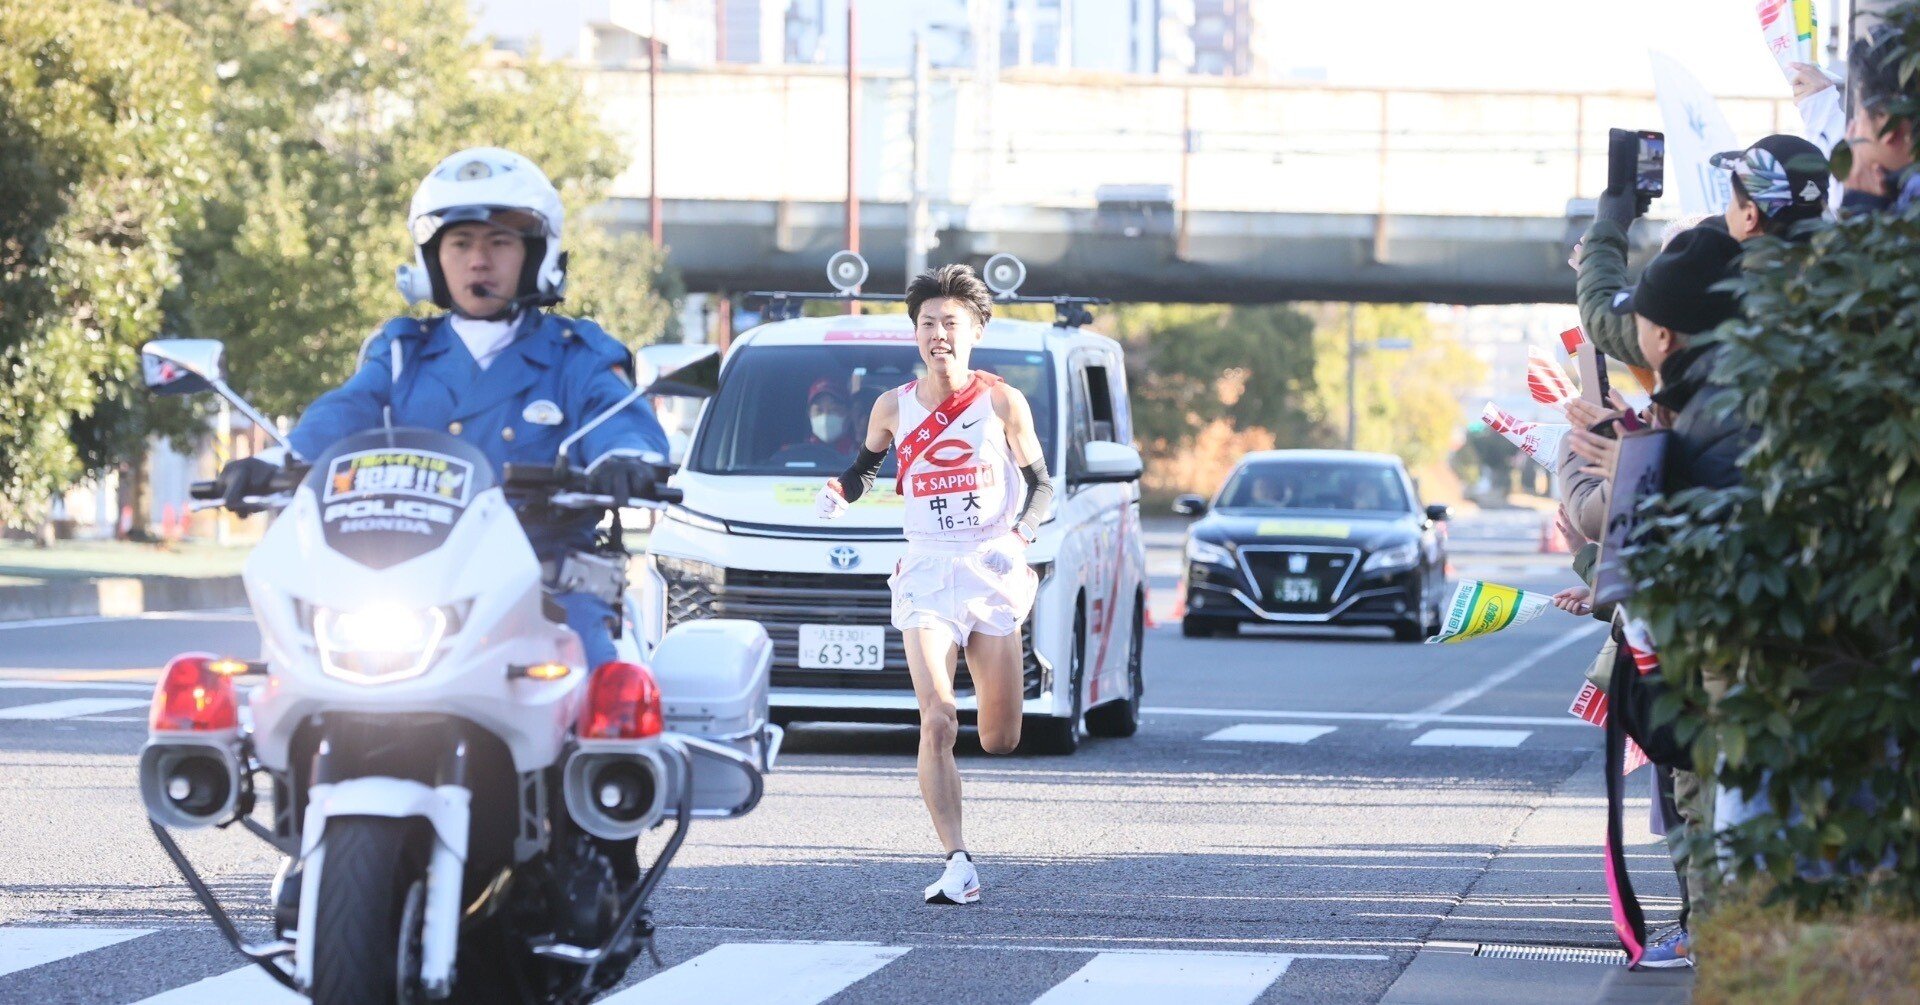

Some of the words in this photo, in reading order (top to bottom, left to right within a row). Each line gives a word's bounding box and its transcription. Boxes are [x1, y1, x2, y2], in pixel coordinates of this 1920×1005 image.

[853, 329, 914, 340] TOYO
[929, 469, 992, 491] SAPPOO
[324, 500, 453, 524] POLICE
[339, 517, 434, 535] HONDA
[937, 515, 980, 530] 16-12
[818, 644, 879, 665] 63-39
